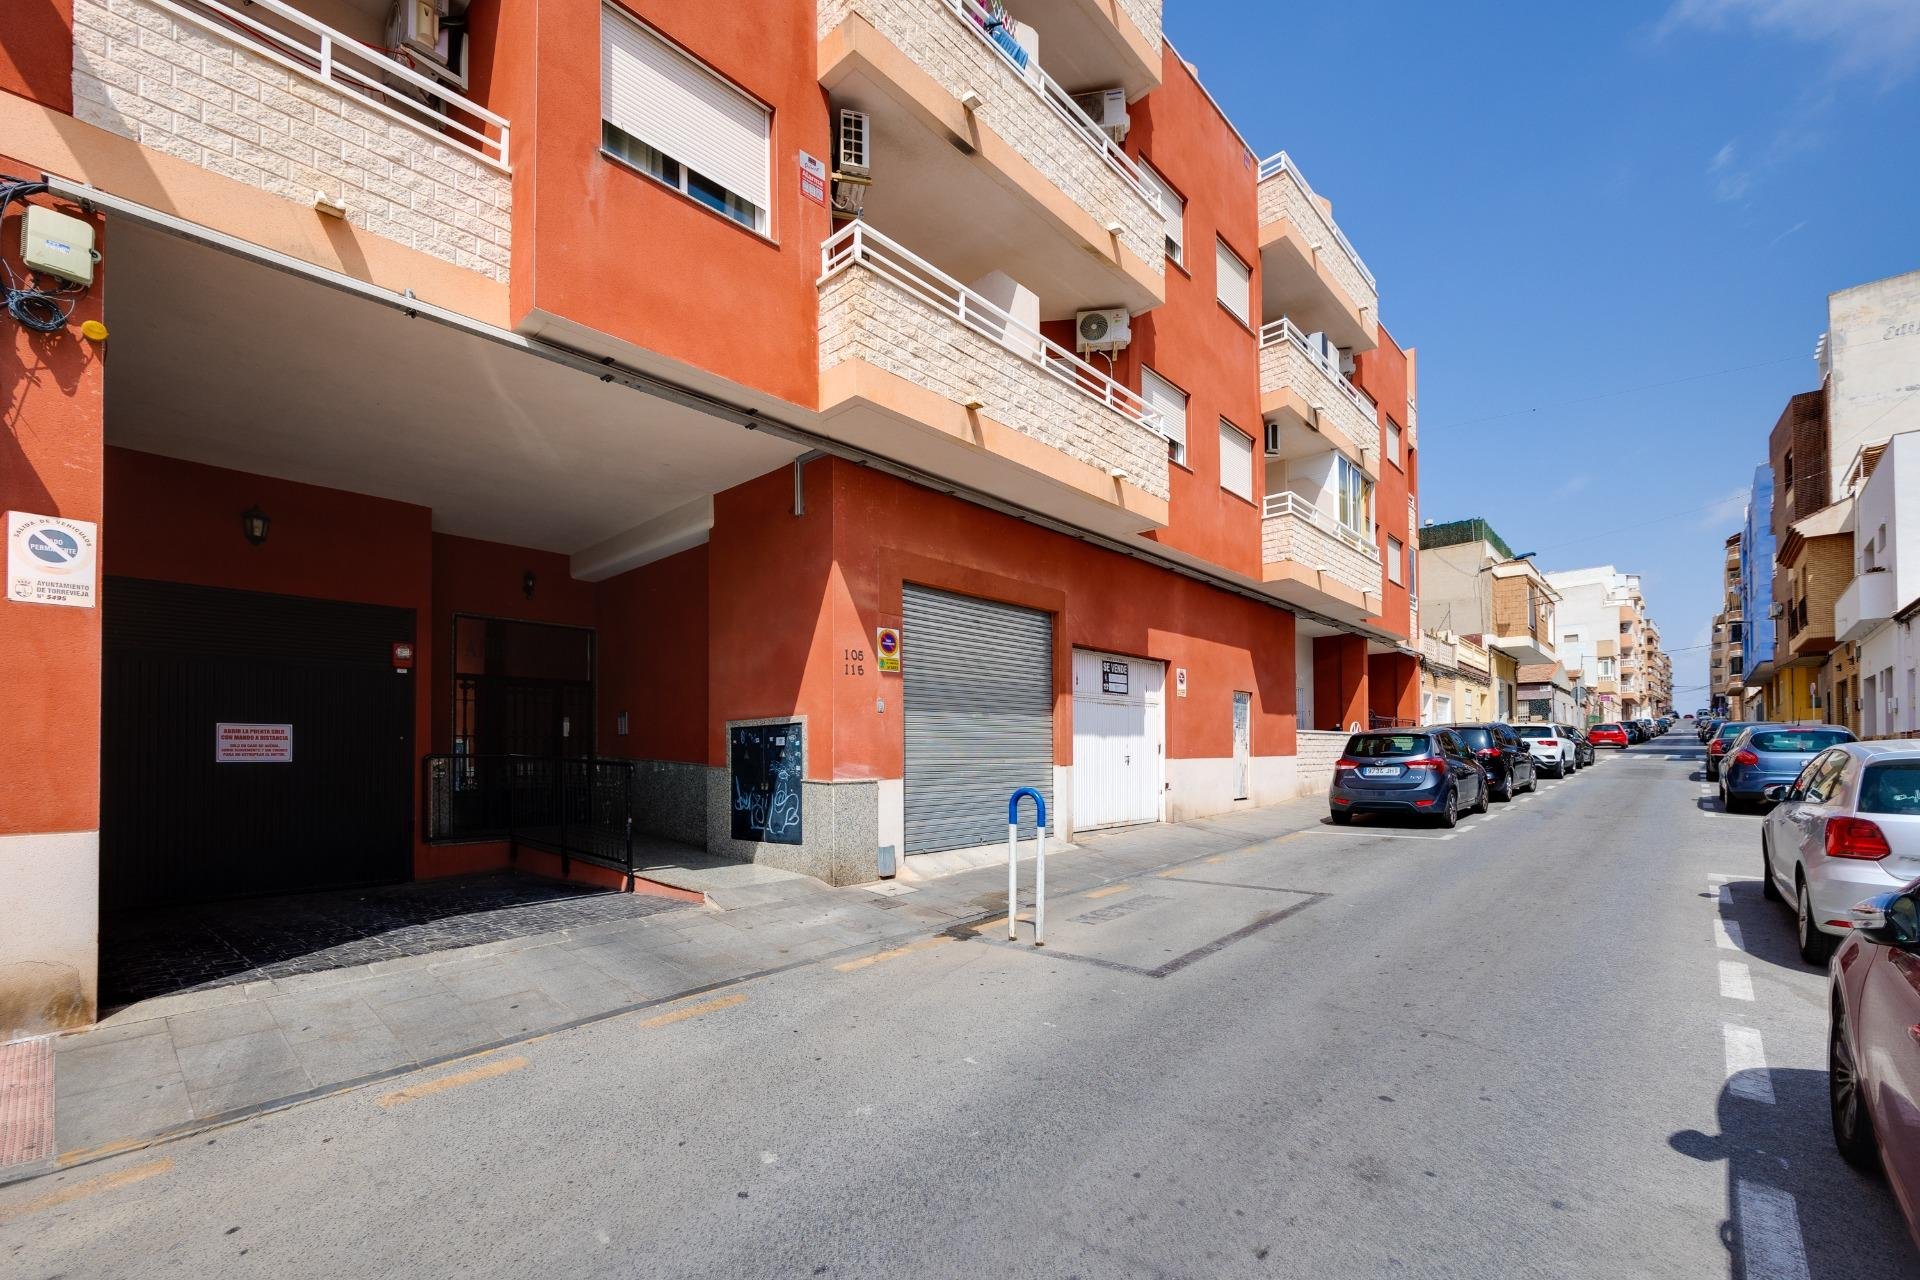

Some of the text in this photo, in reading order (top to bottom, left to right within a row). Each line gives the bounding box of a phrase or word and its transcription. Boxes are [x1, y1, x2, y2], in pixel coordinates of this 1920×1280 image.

[14, 521, 36, 538] SALIDA
[36, 580, 90, 591] AYUNTAMIENTO
[47, 588, 89, 597] TORREVIEJA
[1103, 662, 1128, 674] SE VENDE
